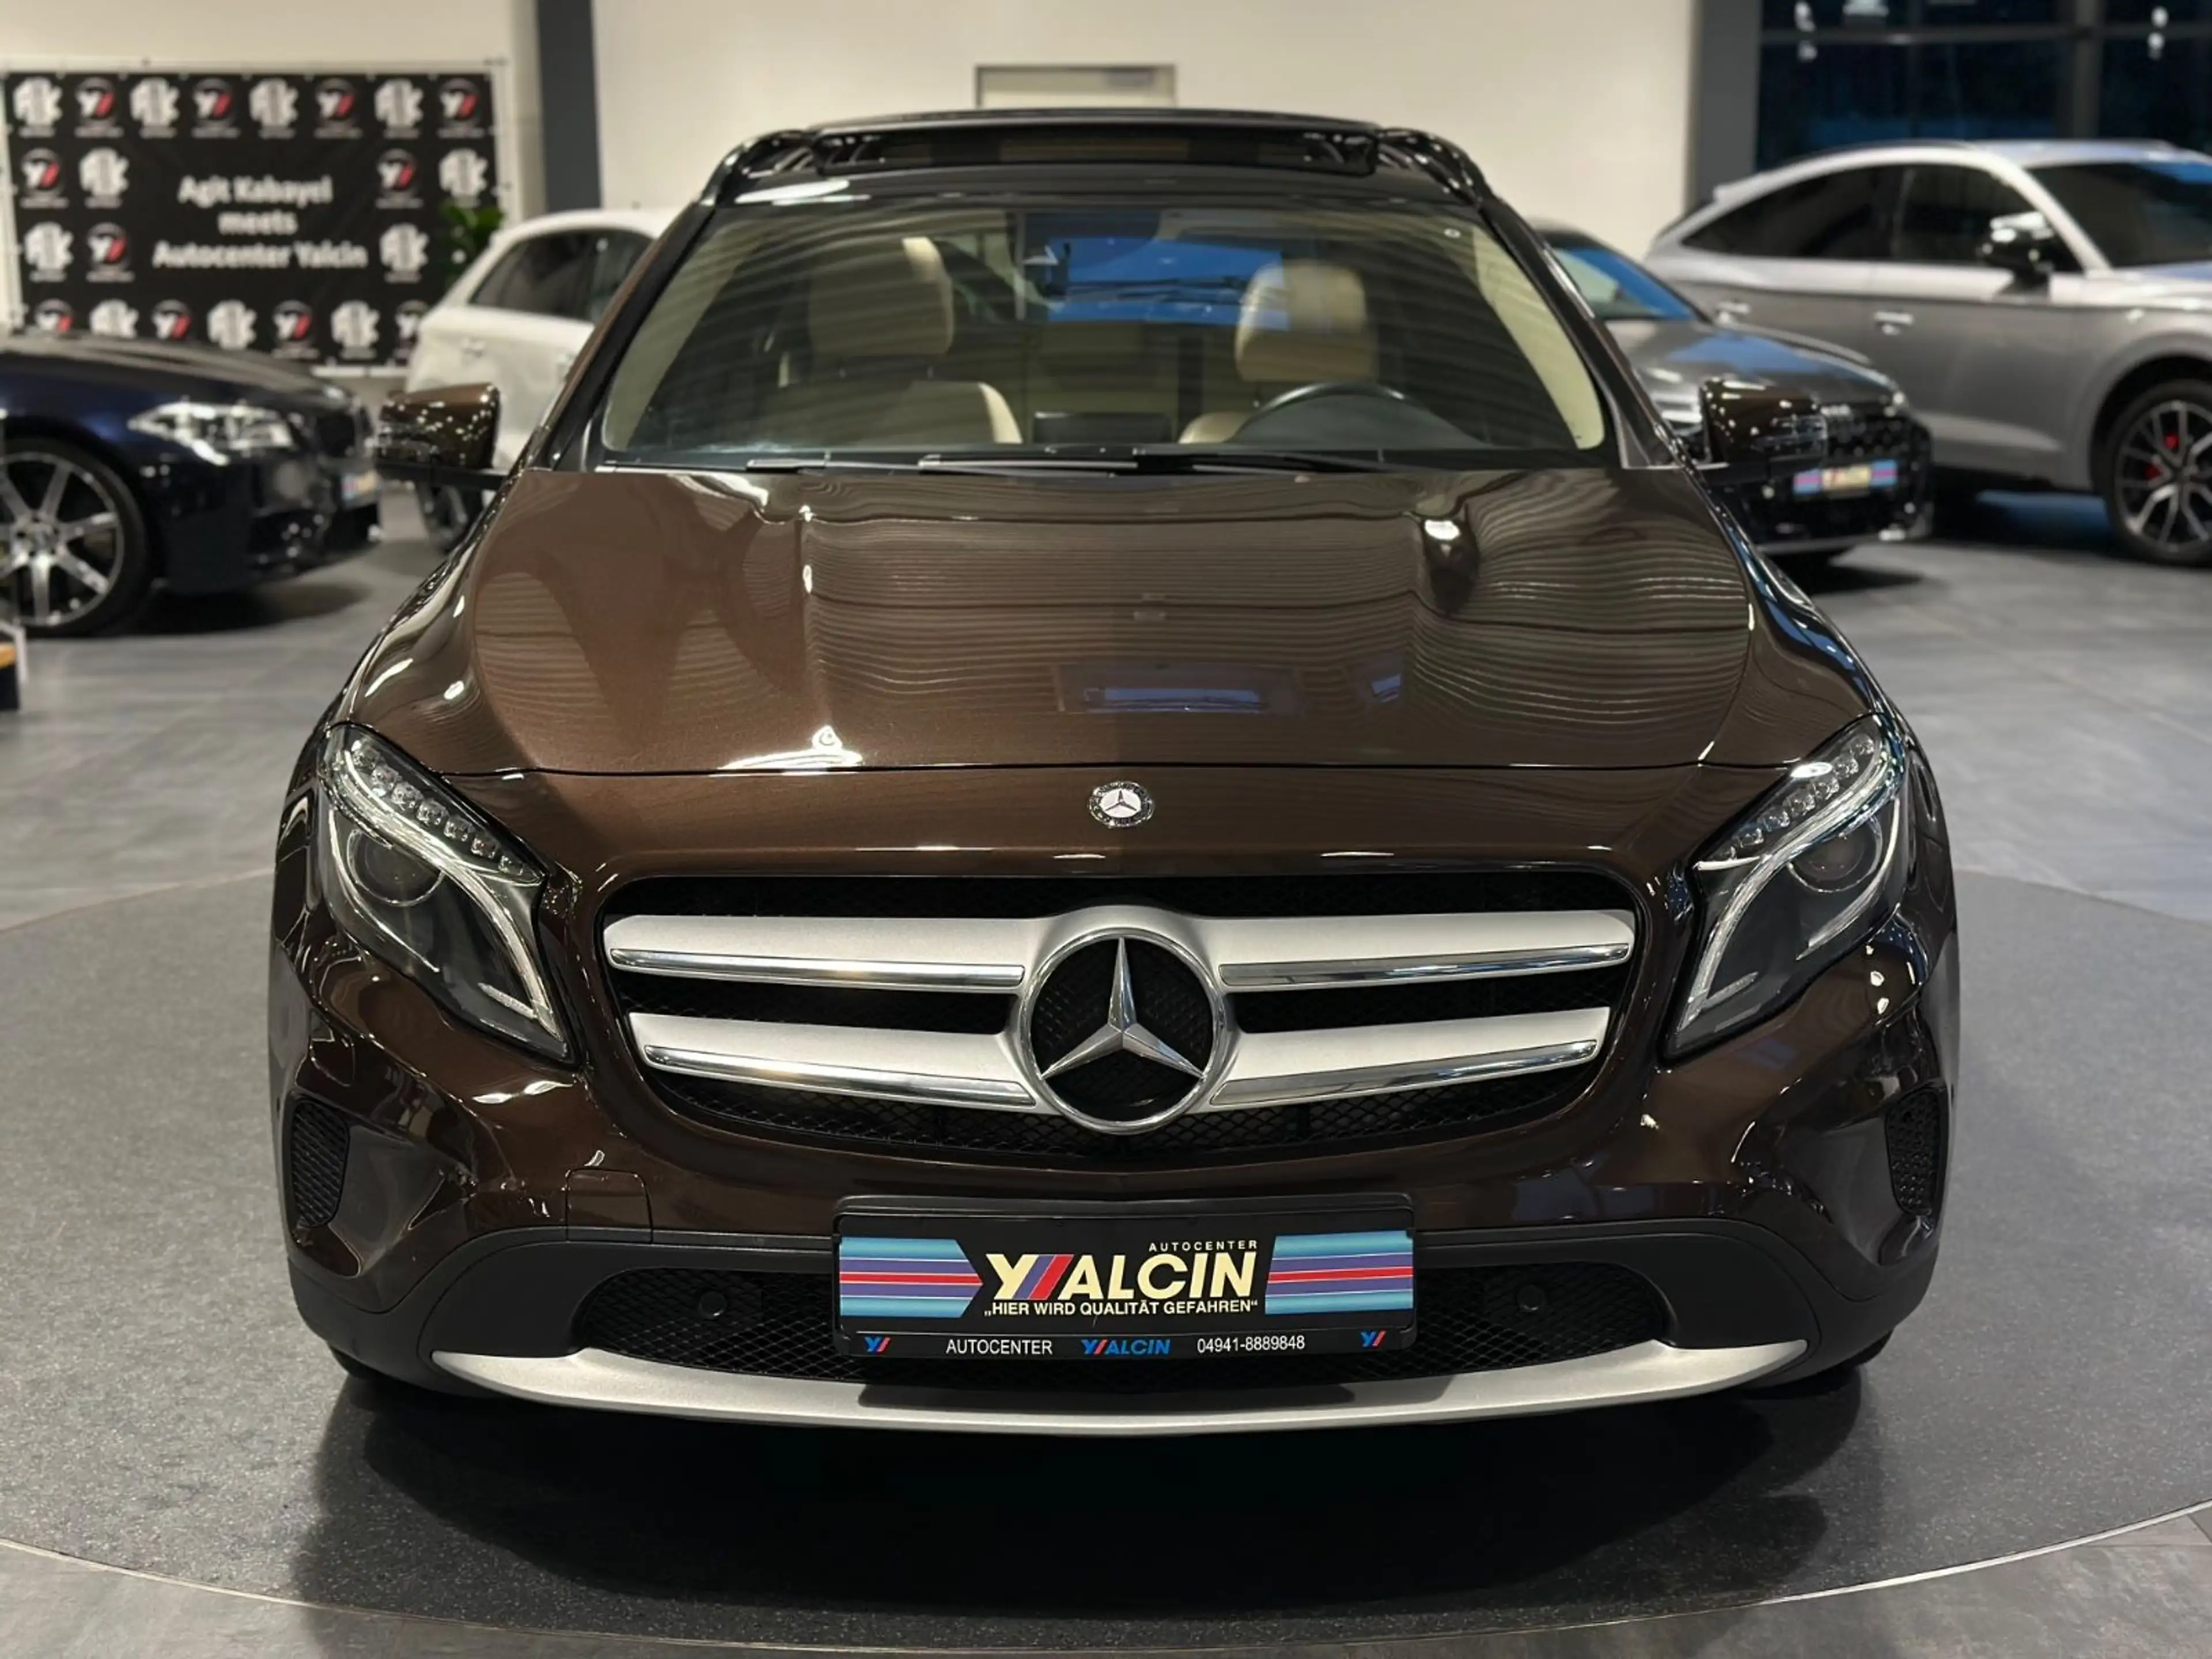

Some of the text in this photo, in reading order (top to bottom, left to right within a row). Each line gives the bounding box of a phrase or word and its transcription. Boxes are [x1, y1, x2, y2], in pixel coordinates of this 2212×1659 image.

[218, 209, 298, 235] meets
[152, 240, 291, 268] Autocenter
[1149, 1240, 1257, 1253] AUTOCENTER
[1033, 1302, 1076, 1316] WIRD
[1080, 1299, 1160, 1316] QUALITÄT
[945, 1338, 1053, 1355] AUTOCENTER
[1197, 1335, 1305, 1354] 04941-8889848
